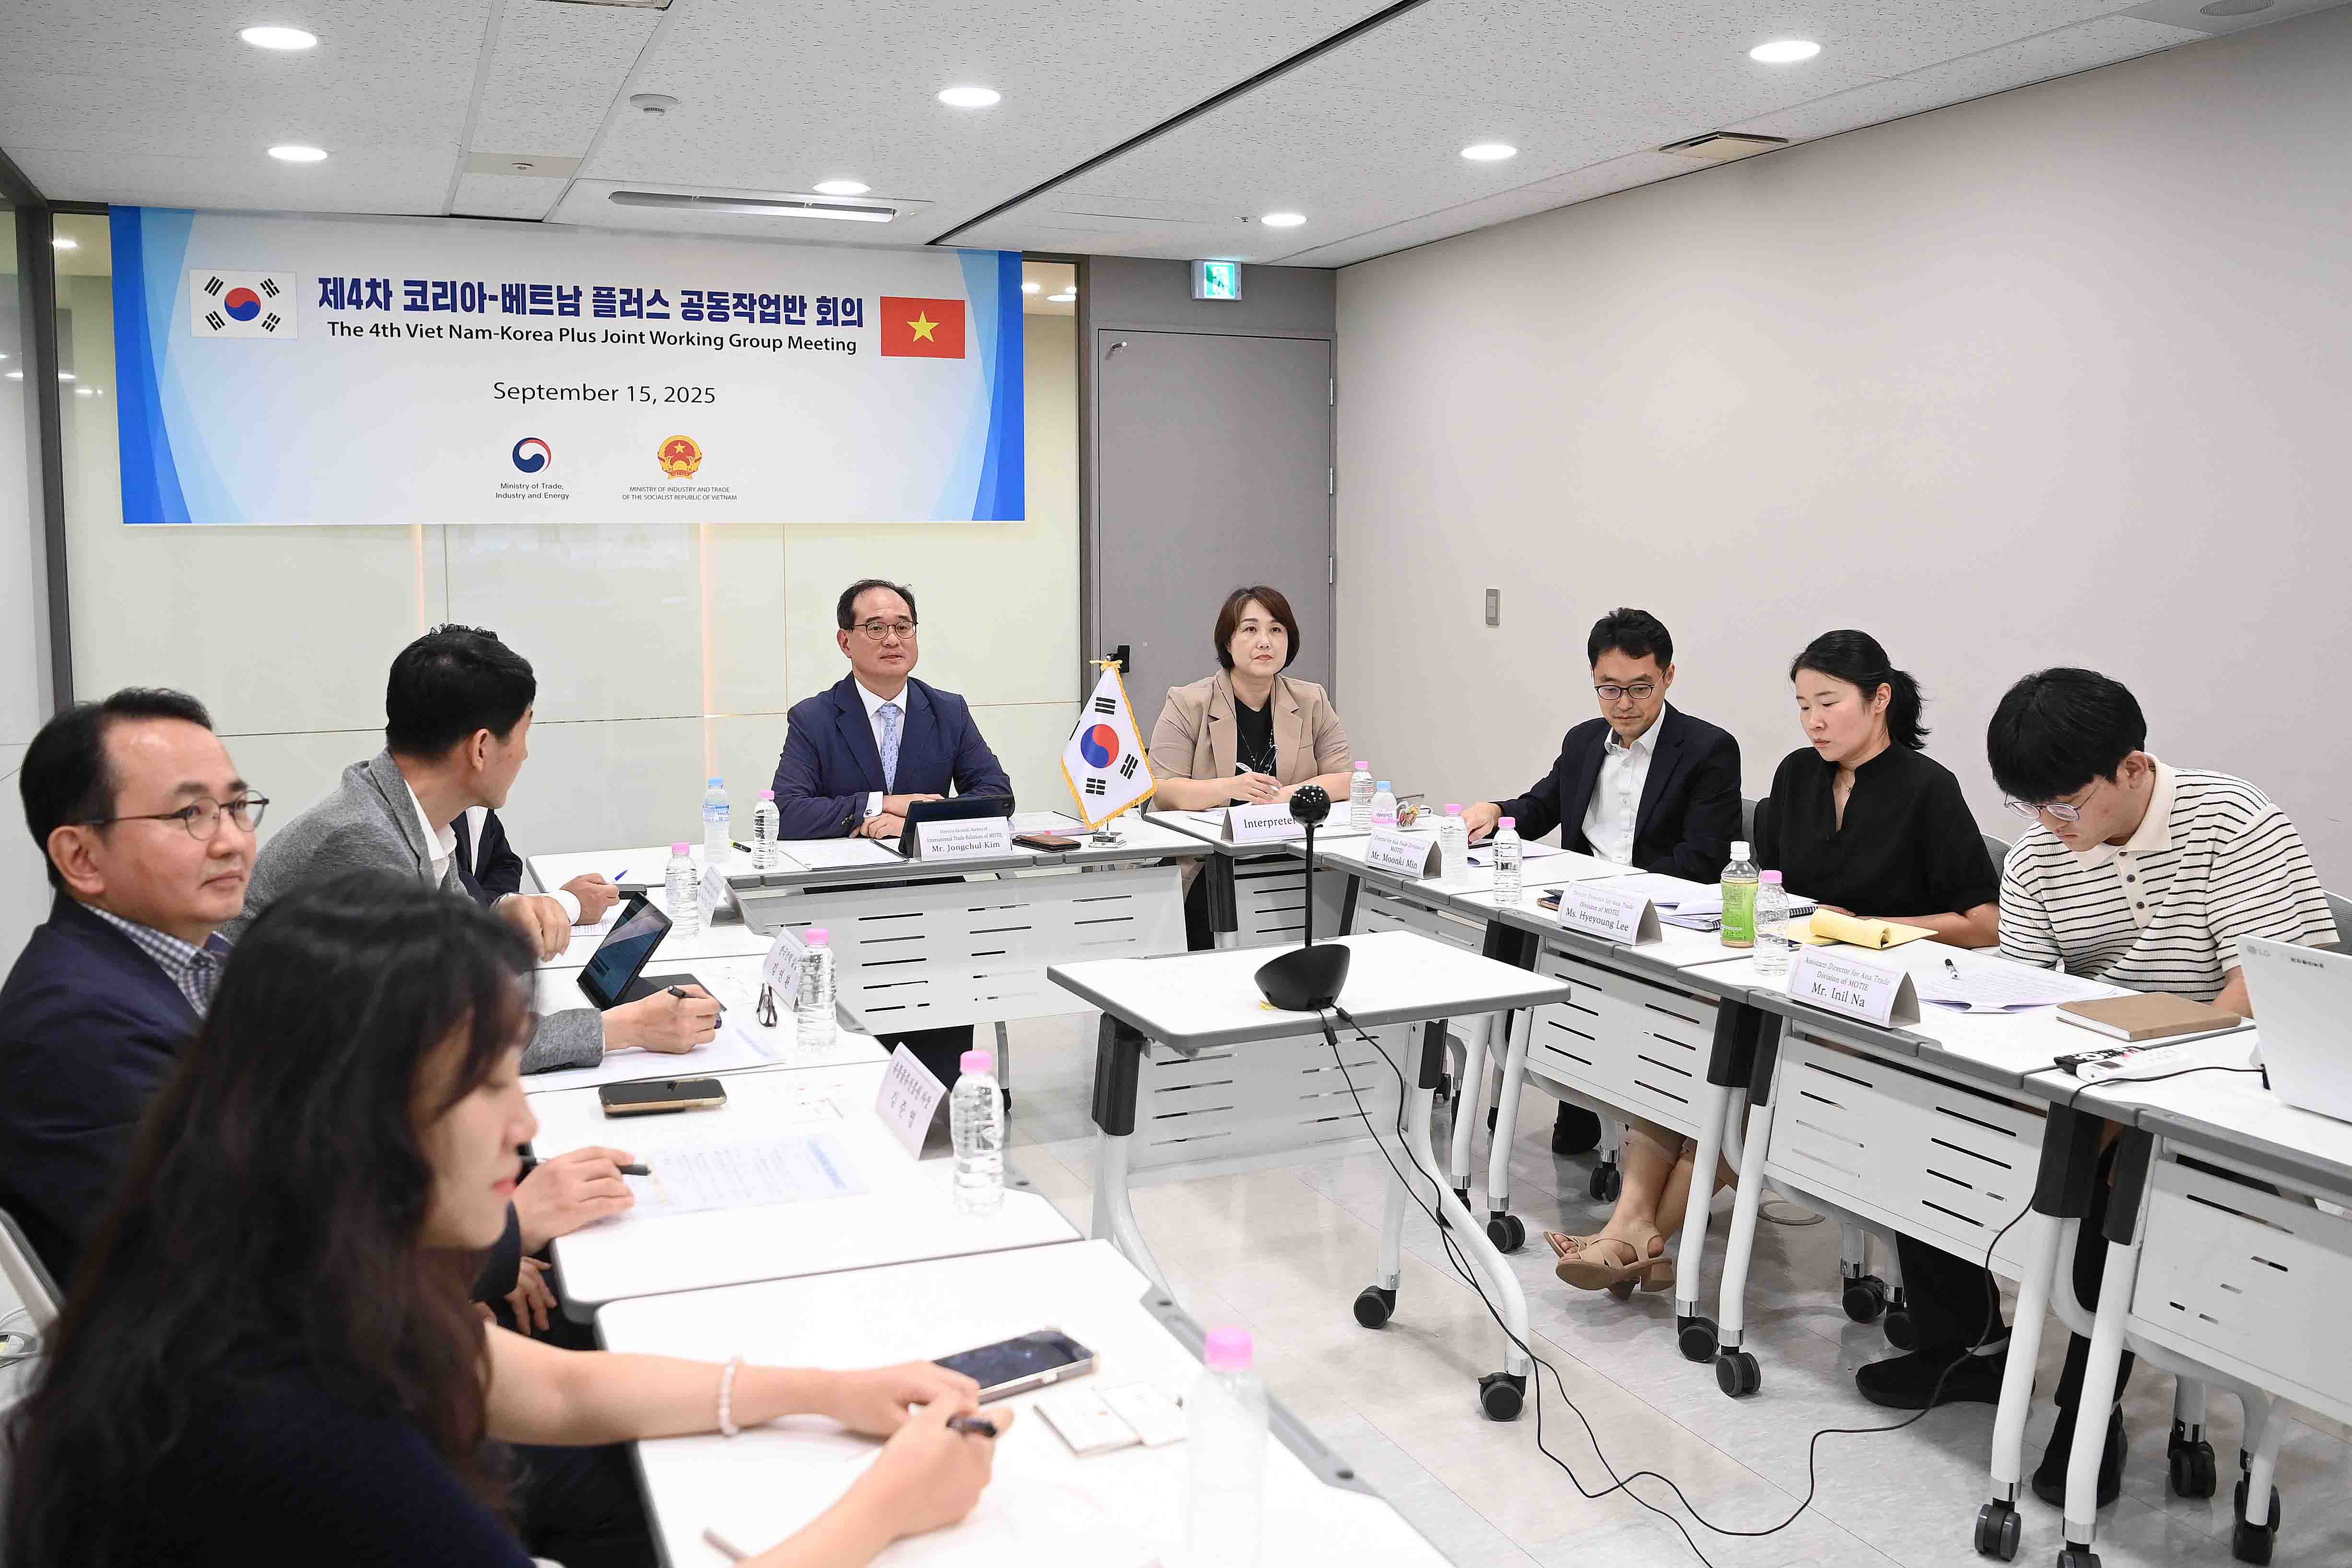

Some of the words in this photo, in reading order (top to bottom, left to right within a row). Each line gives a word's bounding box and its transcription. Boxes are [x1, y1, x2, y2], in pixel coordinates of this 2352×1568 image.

[318, 277, 393, 311] 제4차
[403, 280, 583, 317] 코리아-베트남
[592, 286, 670, 320] 플러스
[681, 290, 808, 326] 공동작업반
[815, 295, 864, 328] 회의
[328, 321, 364, 337] The
[369, 322, 401, 338] 4th
[406, 323, 443, 339] Viet
[449, 324, 553, 342] Nam-Korea
[560, 327, 597, 343] Plus
[601, 329, 646, 344] Joint
[649, 330, 724, 350] Working
[729, 334, 783, 352] Group
[788, 336, 857, 355] Meeting
[494, 382, 619, 404] September
[626, 385, 657, 405] 15,
[664, 386, 716, 403] 2025
[947, 842, 981, 852] Jongchul
[1371, 850, 1380, 860] Mr.
[1382, 853, 1404, 866] Moonki
[1405, 859, 1418, 869] Min
[1580, 902, 1598, 911] Division
[1566, 908, 1576, 918] Ms.
[1579, 911, 1614, 929] Hyeyoung
[1616, 920, 1629, 931] Lee
[1804, 956, 1827, 968] Assistant
[1828, 963, 1850, 975] Director
[1852, 968, 1860, 977] for
[1861, 972, 1872, 980] Asia
[1874, 975, 1891, 985] Trade
[1816, 971, 1839, 983] Division
[1848, 979, 1870, 991] MOTIE
[1811, 982, 1827, 996] Mr.
[1832, 988, 1849, 1002] Inil
[1851, 993, 1865, 1007] Na
